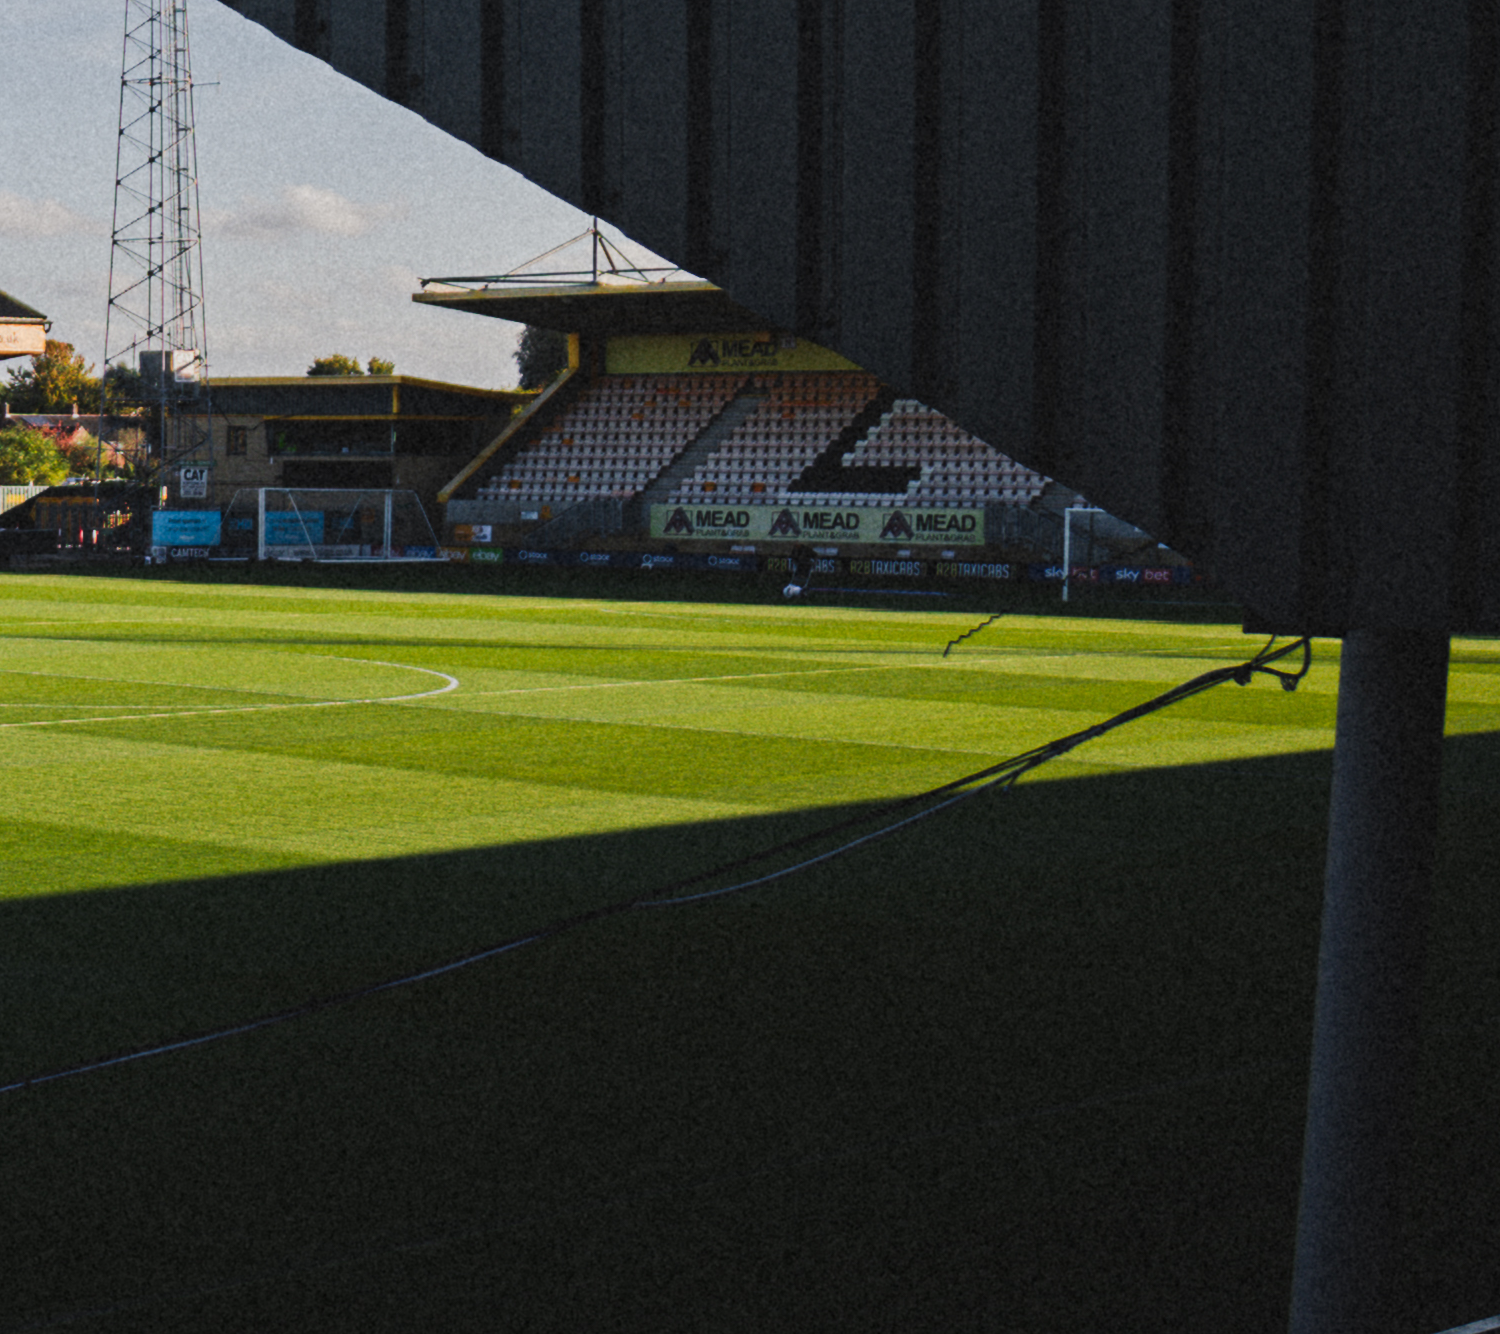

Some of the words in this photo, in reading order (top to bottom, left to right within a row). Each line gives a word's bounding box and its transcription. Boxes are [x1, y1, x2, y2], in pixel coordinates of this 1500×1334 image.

[183, 468, 205, 482] CAT
[696, 510, 750, 529] MEAD
[803, 512, 860, 530] MEAD
[915, 513, 976, 532] MEAD
[472, 549, 500, 562] ebay
[1116, 568, 1140, 582] sky
[1145, 568, 1170, 581] bet
